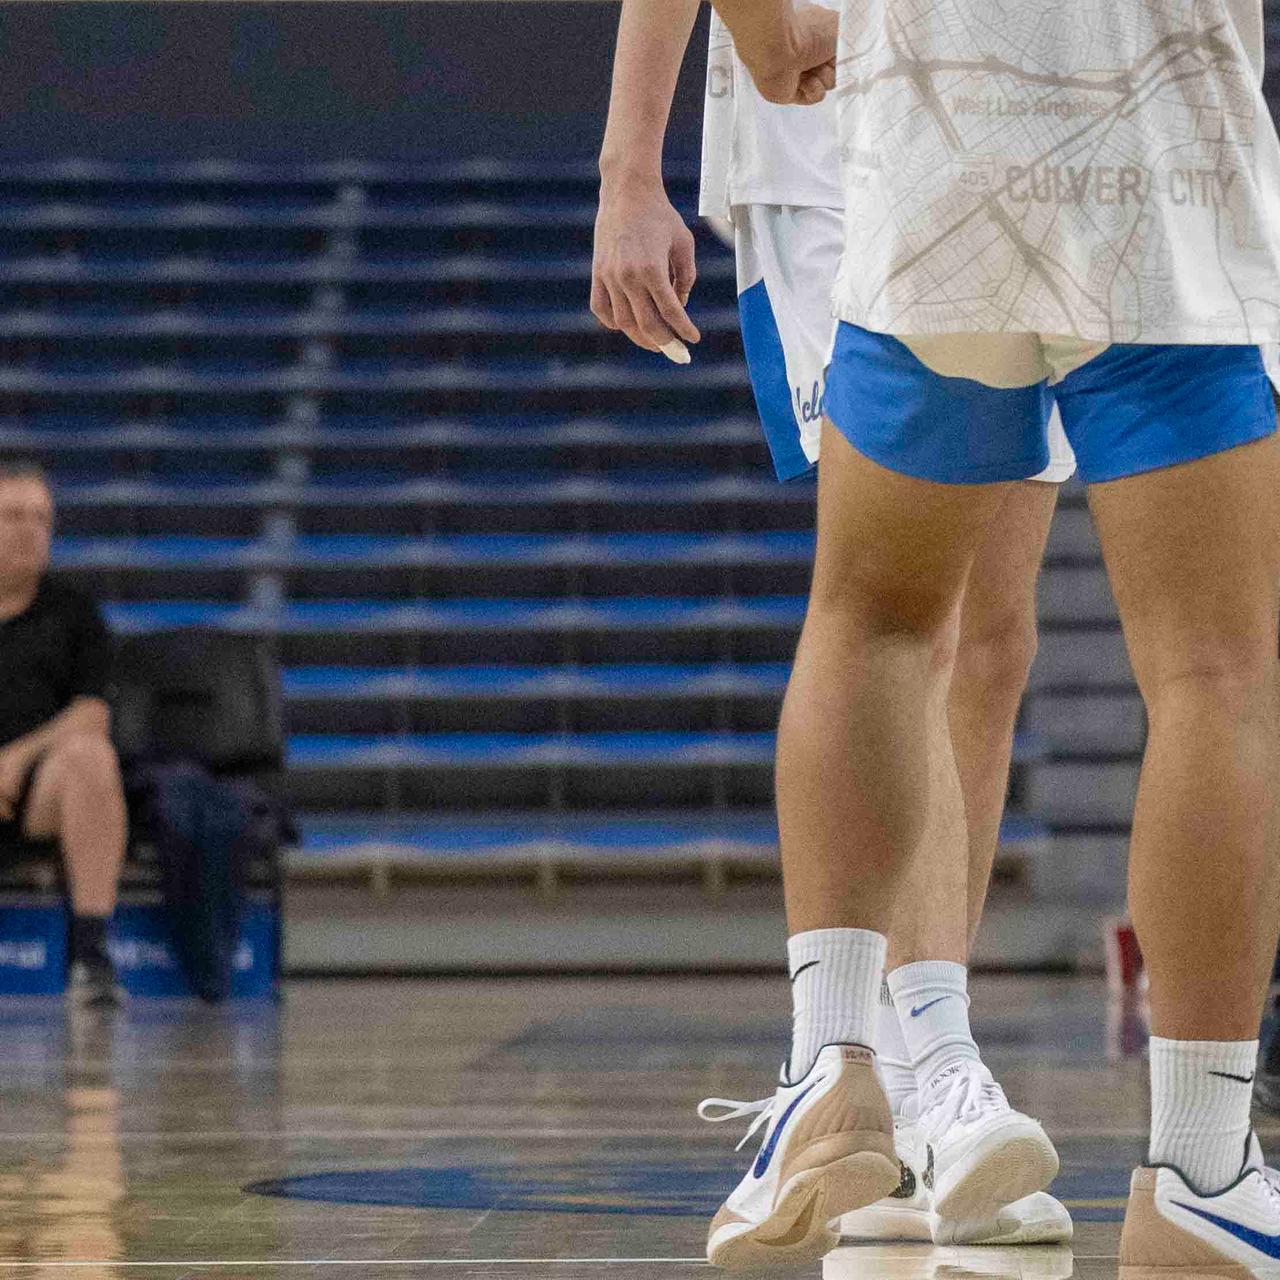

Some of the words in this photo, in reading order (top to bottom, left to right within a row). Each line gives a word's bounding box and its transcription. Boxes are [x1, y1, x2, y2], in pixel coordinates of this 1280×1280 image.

[958, 170, 990, 187] 405
[1005, 165, 1146, 206] CULVER
[1169, 167, 1238, 208] CITY
